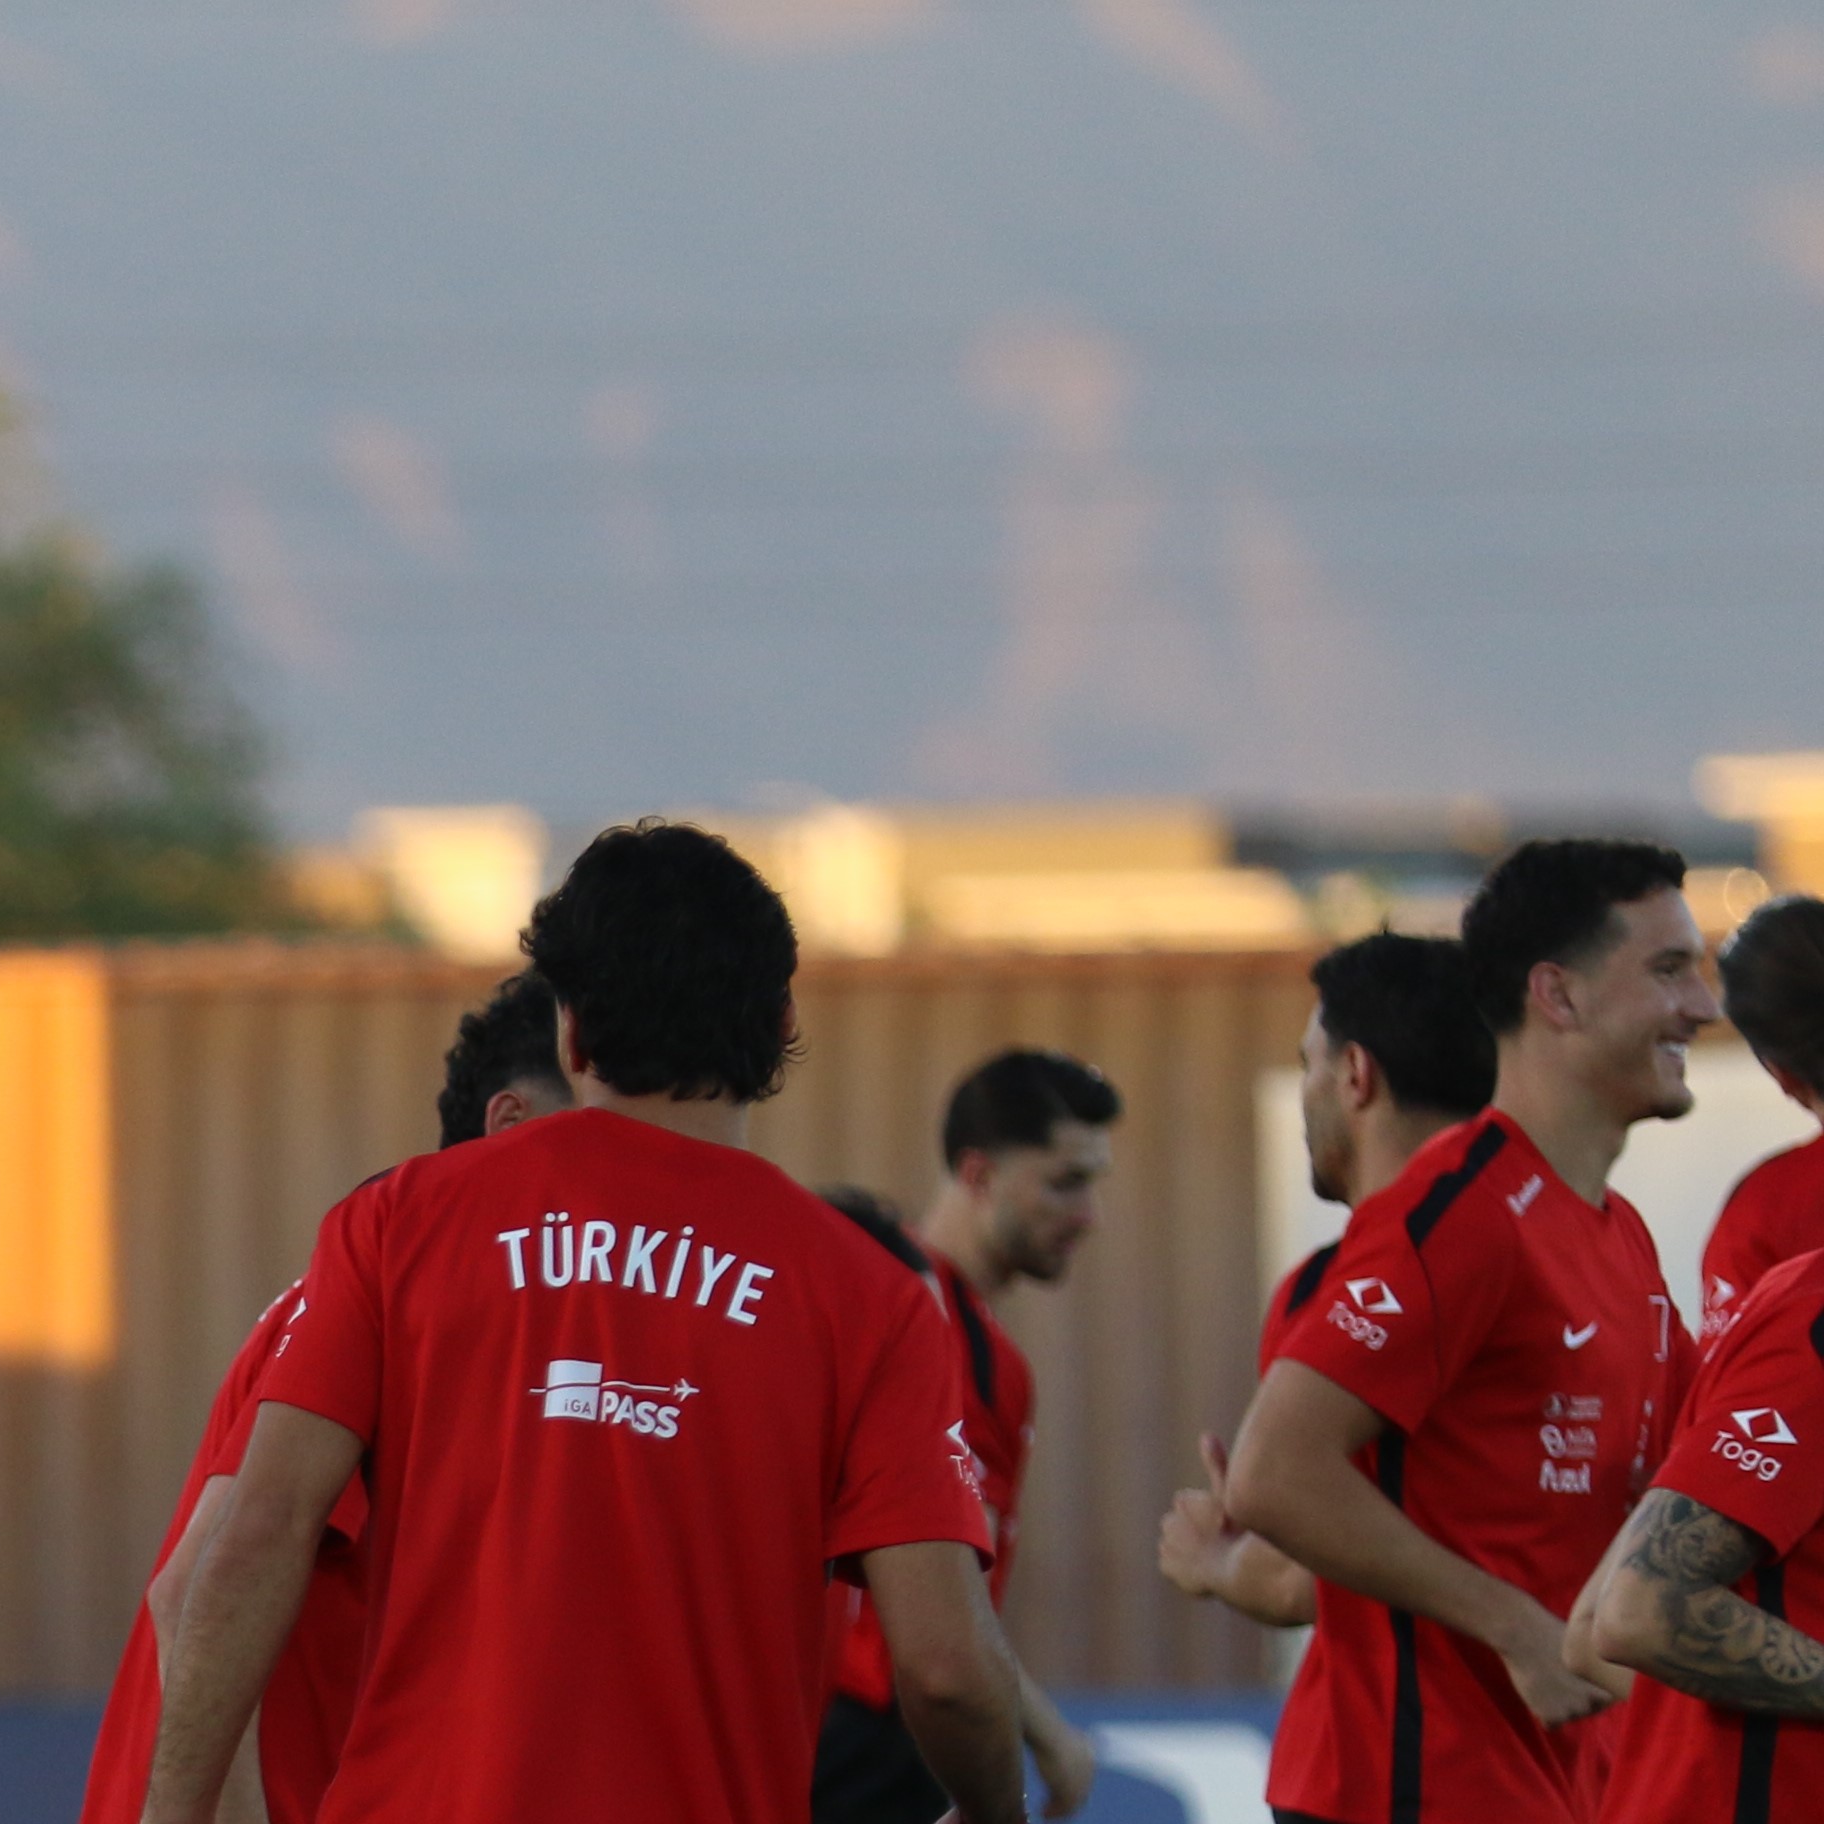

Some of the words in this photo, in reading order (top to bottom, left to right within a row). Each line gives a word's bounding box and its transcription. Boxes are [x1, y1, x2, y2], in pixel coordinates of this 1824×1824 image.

[497, 1211, 775, 1326] TÜRKİYE
[601, 1390, 681, 1439] PASS
[1710, 1430, 1783, 1482] Togg
